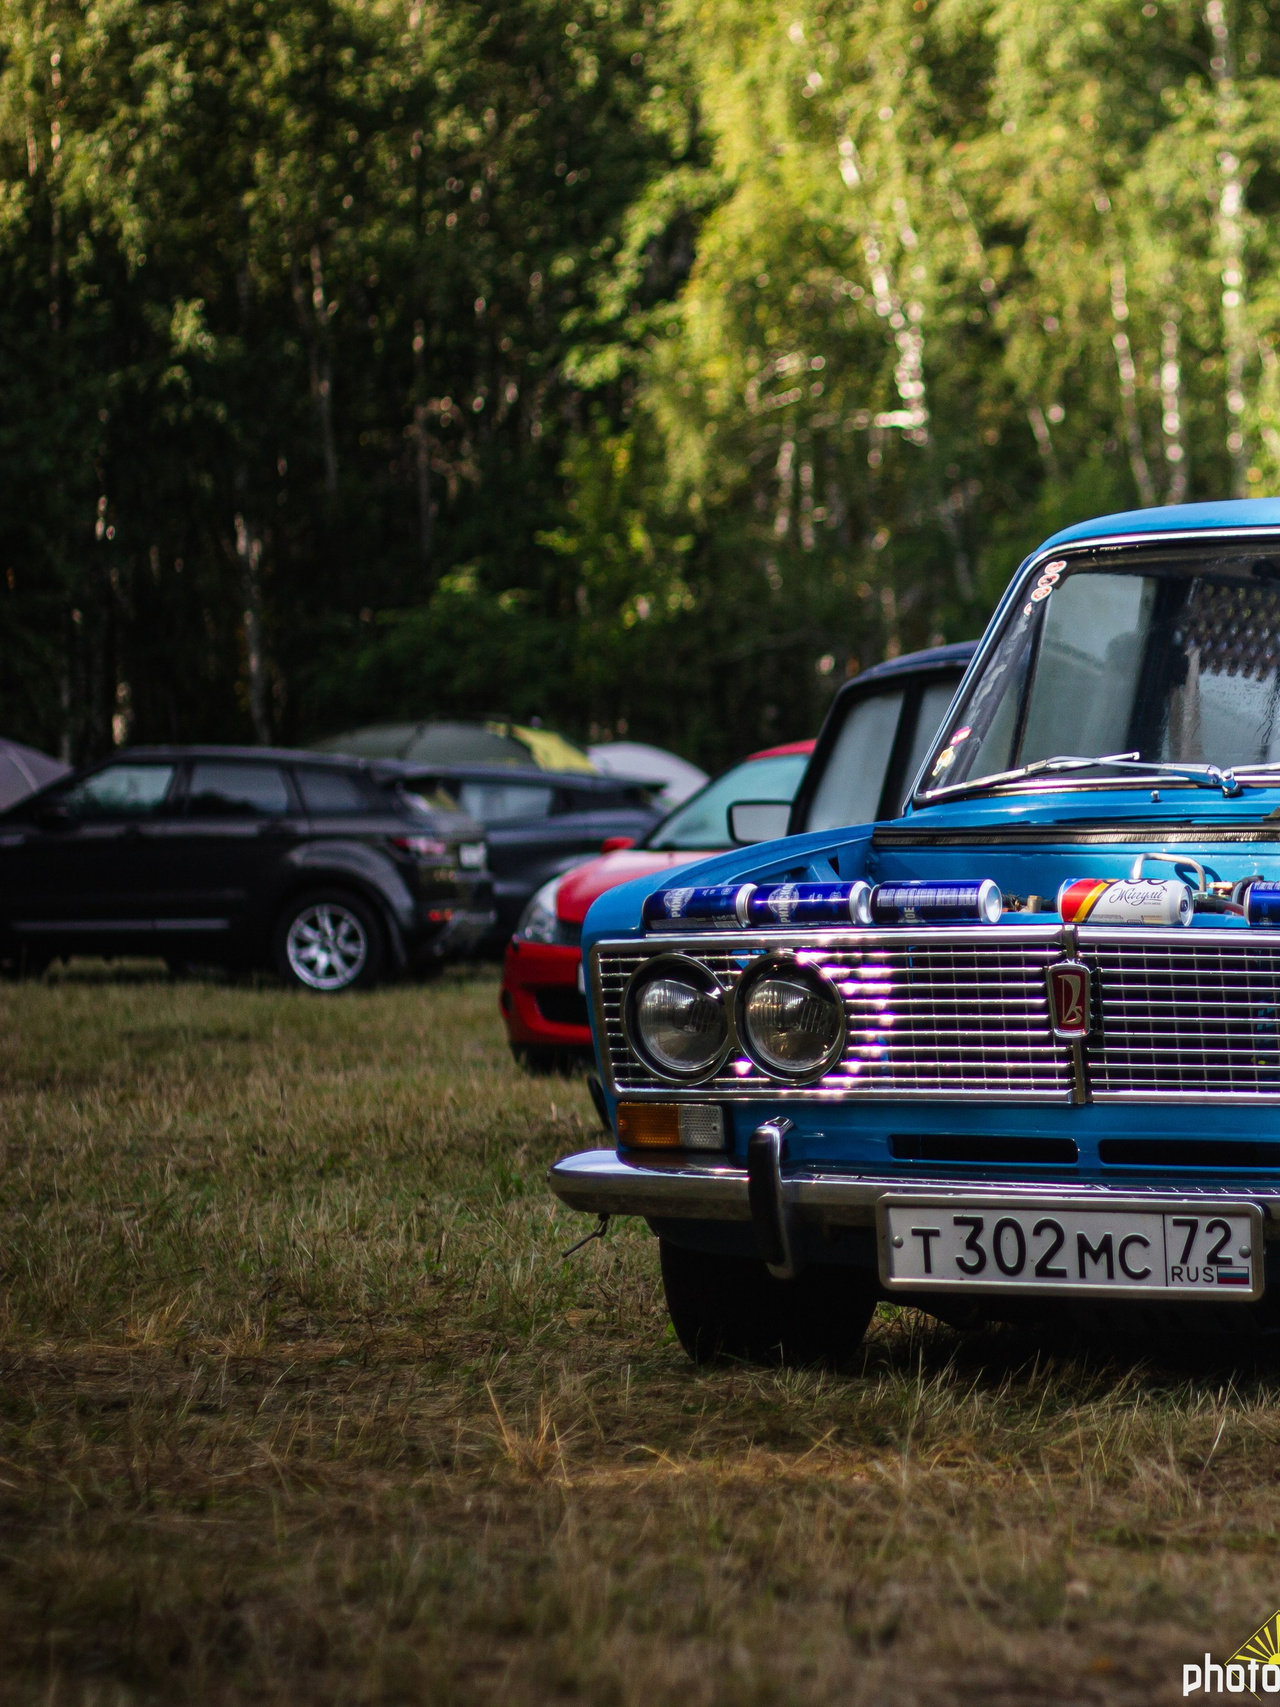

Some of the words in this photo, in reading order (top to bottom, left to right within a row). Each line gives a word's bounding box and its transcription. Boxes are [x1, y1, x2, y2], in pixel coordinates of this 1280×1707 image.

[778, 884, 796, 924] РИЖСКО
[1172, 1217, 1233, 1265] 72
[1171, 1266, 1215, 1283] RUS
